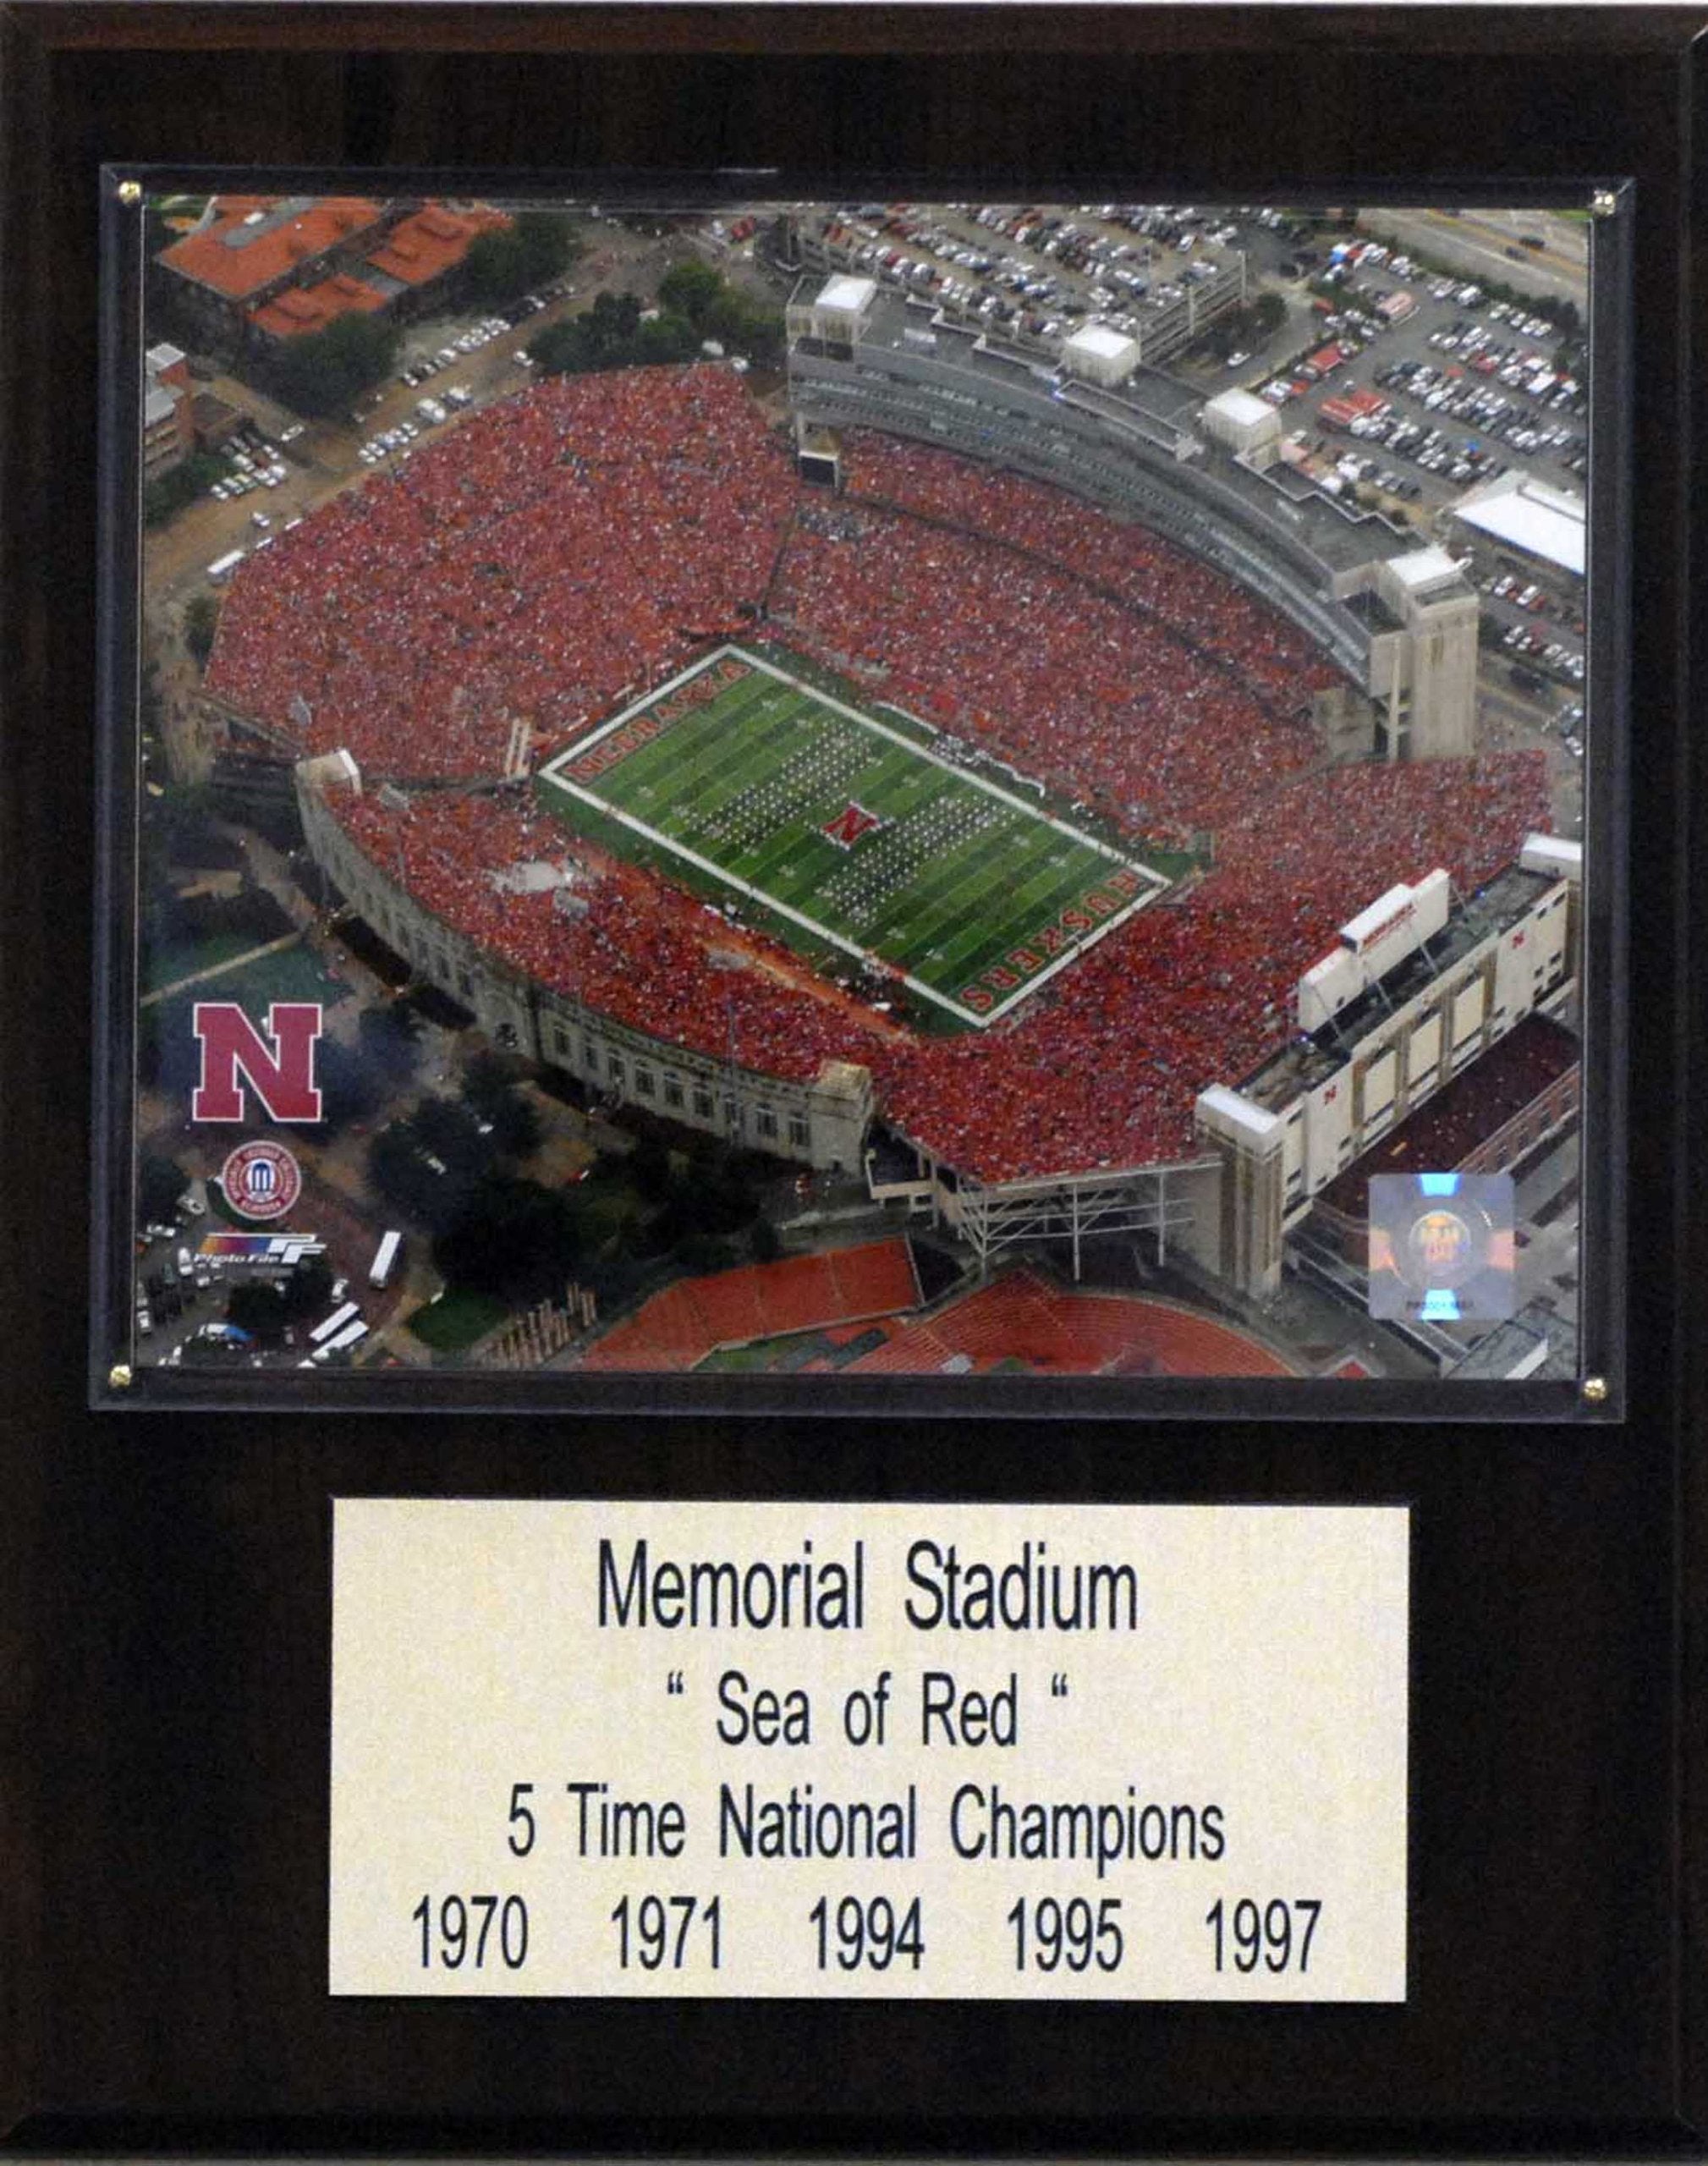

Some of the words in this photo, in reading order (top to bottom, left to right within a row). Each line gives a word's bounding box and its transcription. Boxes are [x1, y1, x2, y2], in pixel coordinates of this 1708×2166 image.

[820, 800, 881, 851] N
[960, 868, 1139, 1011] HUSKERS
[193, 1002, 322, 1122] N
[598, 1538, 863, 1630] Memorial
[905, 1539, 1137, 1630] Stadium
[717, 1670, 810, 1745] Sea
[844, 1671, 892, 1746] of
[922, 1672, 1017, 1746] Red
[508, 1783, 535, 1856] 5
[567, 1783, 686, 1857] Time
[719, 1784, 916, 1858] National
[950, 1784, 1225, 1878] Champions
[413, 1894, 529, 1970] 1970
[612, 1895, 720, 1971] 1971
[810, 1896, 925, 1971] 1994
[1008, 1897, 1123, 1972] 1995
[1205, 1898, 1322, 1973] 1997
